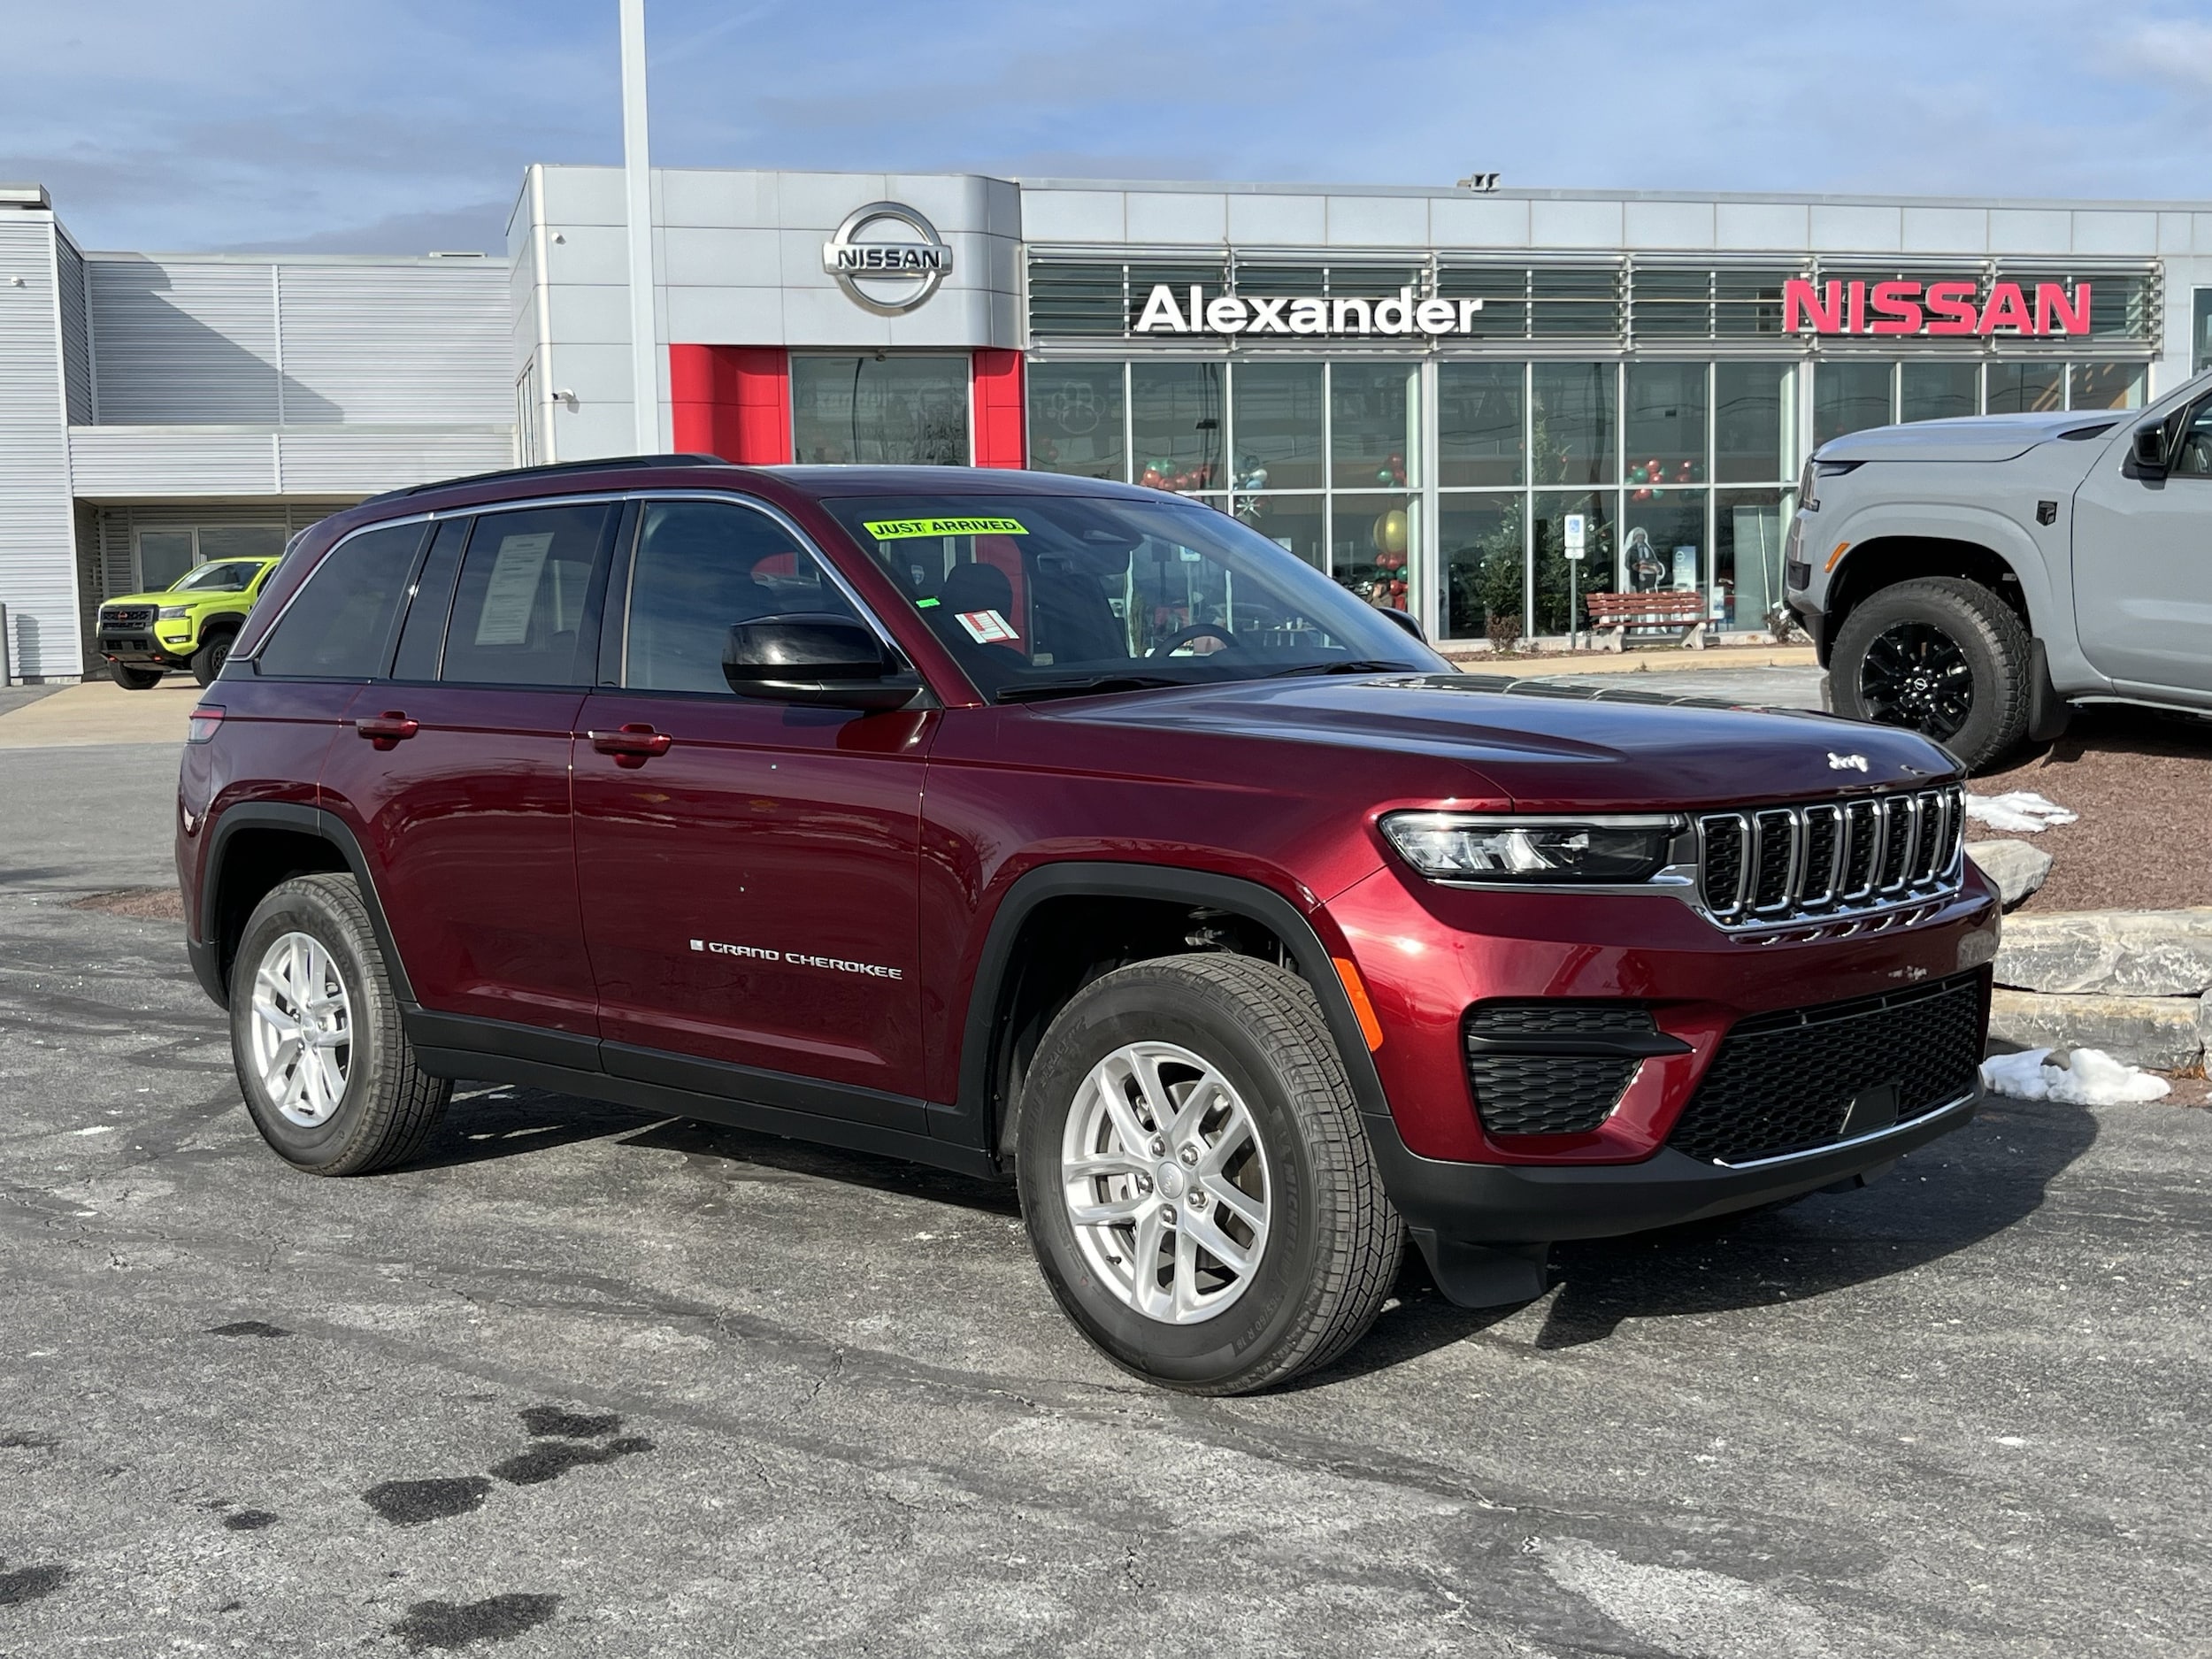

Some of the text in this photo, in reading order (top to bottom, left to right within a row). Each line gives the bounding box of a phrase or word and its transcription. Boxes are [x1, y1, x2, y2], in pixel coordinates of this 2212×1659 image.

[838, 249, 941, 269] NISSAN
[1136, 284, 1483, 334] Alexander
[1783, 280, 2092, 335] NISSAN
[873, 520, 1018, 535] JUST ARRIVED
[1827, 752, 1868, 772] Jeep
[709, 941, 903, 980] GRAND CHEROKEE
